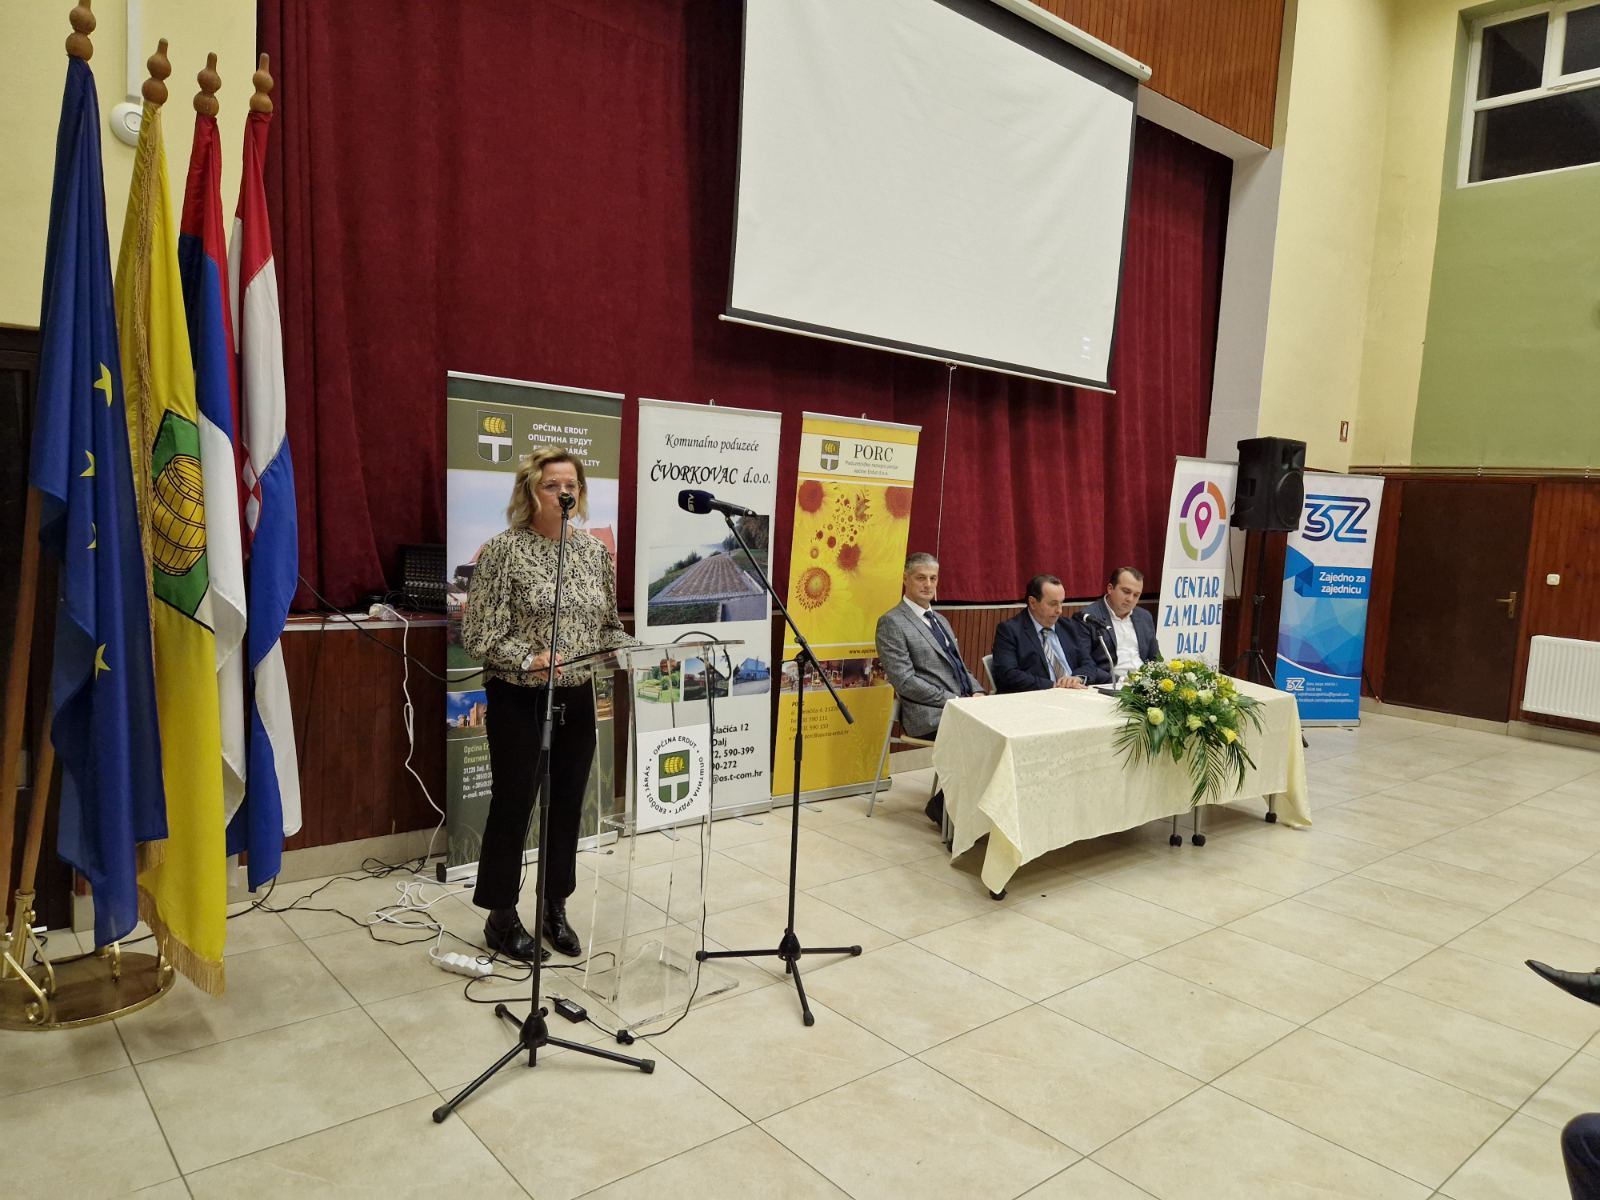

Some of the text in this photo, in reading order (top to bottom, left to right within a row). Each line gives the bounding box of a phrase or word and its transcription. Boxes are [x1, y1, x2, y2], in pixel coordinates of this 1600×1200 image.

[533, 423, 588, 435] OPĆINA ERDUT
[528, 434, 592, 446] ОПШТИНА ЕРДУТ
[665, 434, 759, 453] Komunalno poduzeće
[854, 444, 894, 462] PORC
[650, 460, 770, 484] ČVORKOVAC d.o.o.
[1319, 572, 1354, 584] Zajedno
[1175, 576, 1220, 599] CENTAR
[1321, 585, 1361, 595] zajednicu
[1164, 603, 1222, 627] ZA MLADE
[1176, 632, 1207, 655] DALJ
[741, 723, 748, 731] 12
[653, 736, 697, 755] OPĆINA ERDUT
[713, 737, 727, 747] Dalj
[724, 746, 755, 757] 590-399
